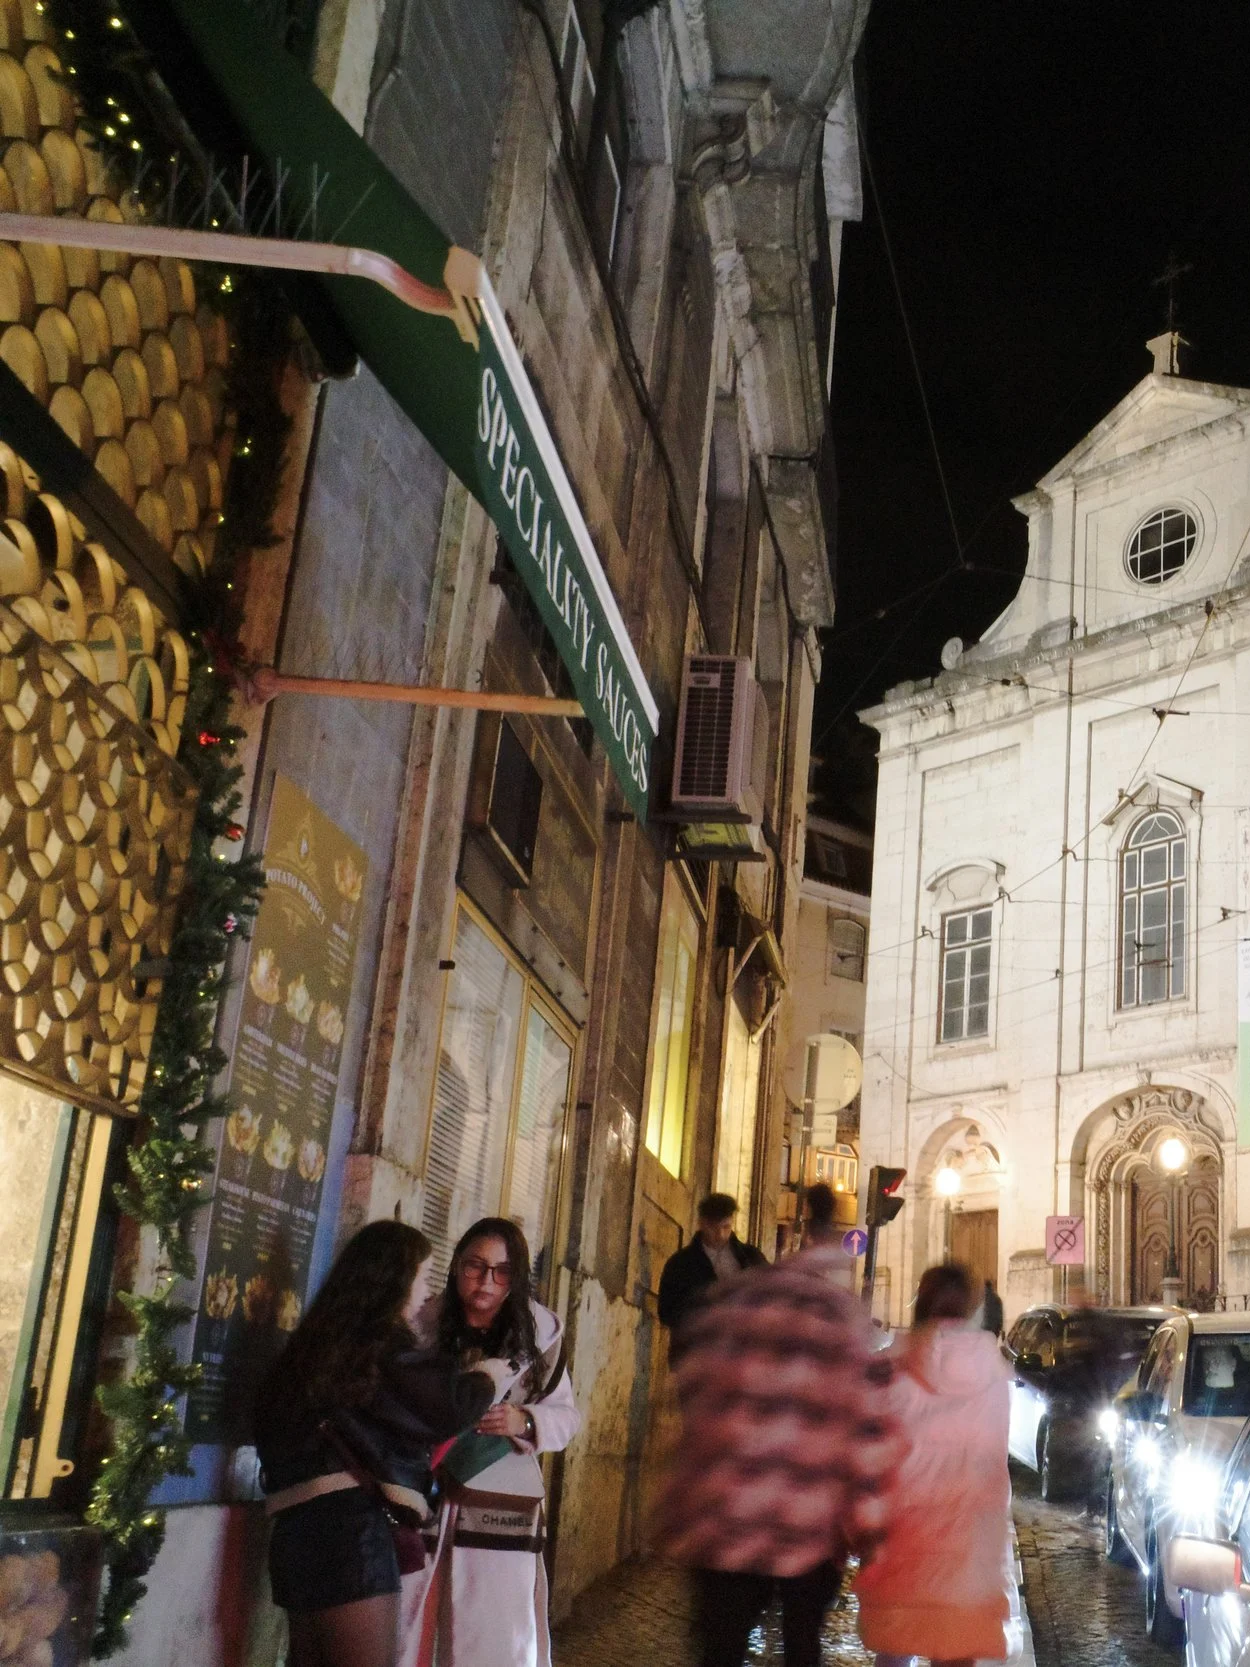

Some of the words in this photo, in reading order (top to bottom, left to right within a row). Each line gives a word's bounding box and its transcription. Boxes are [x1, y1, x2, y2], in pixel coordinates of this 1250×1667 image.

[477, 367, 597, 673] SPECIALITY
[596, 642, 648, 793] SAUCES
[481, 1514, 533, 1527] CHANEL
